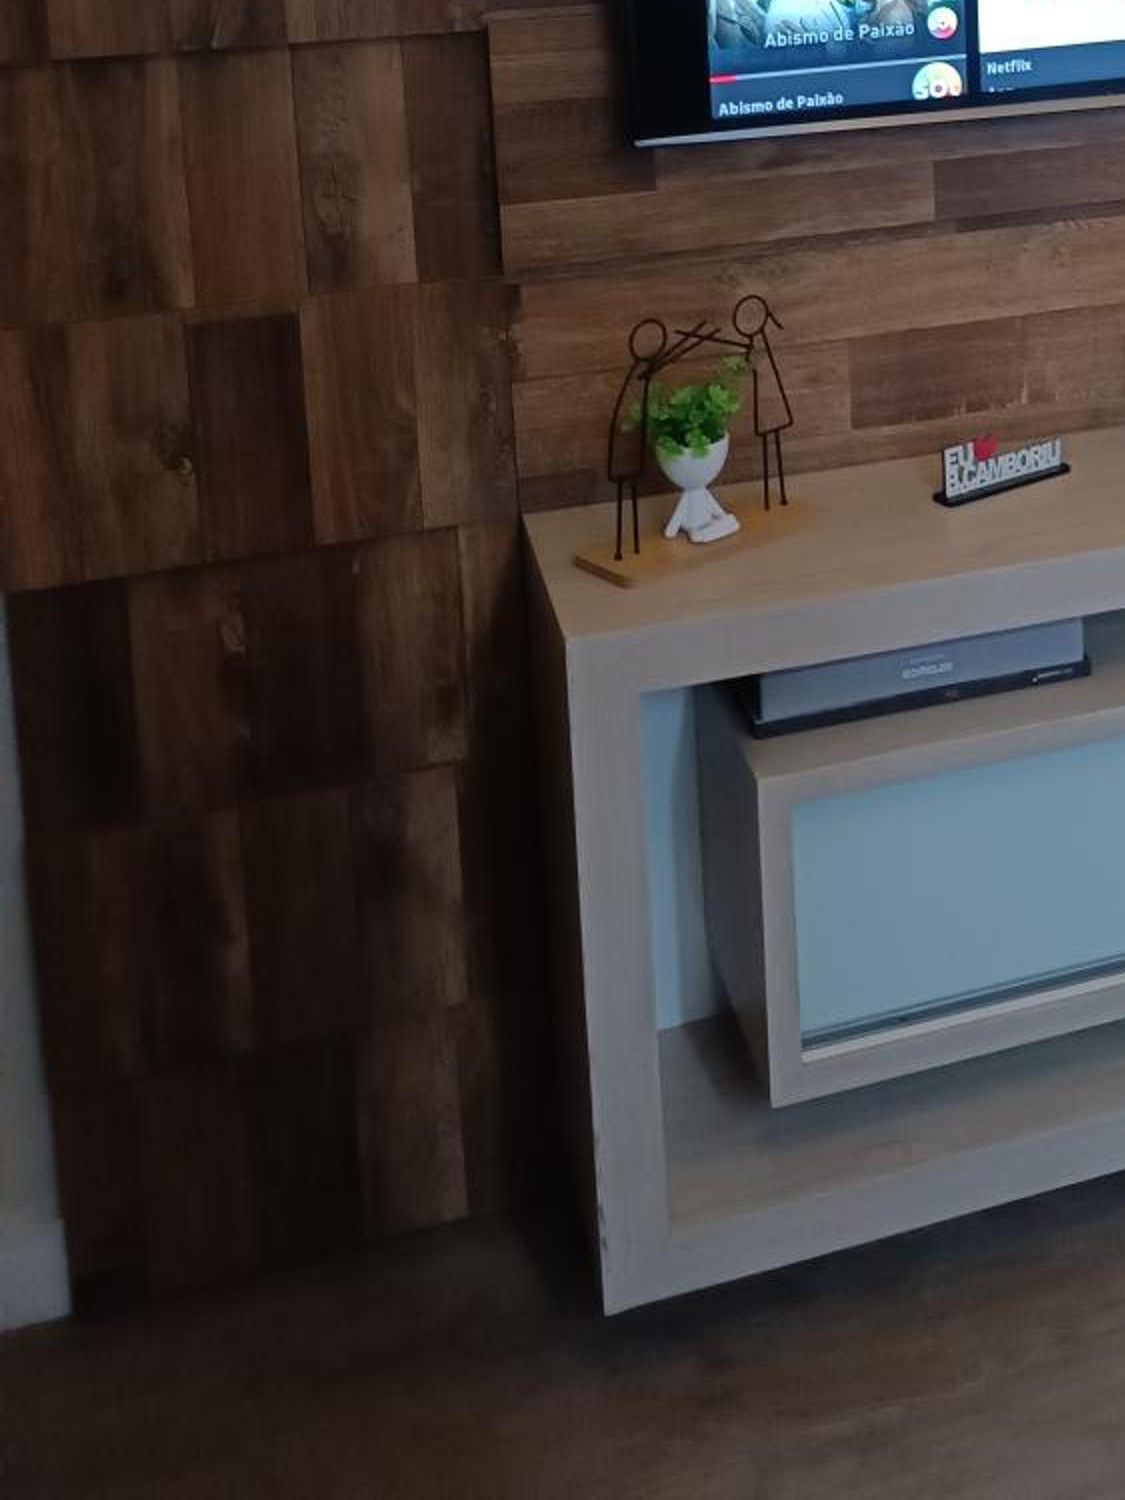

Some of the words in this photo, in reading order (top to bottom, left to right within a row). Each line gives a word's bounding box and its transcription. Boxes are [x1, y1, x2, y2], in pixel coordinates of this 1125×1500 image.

[763, 32, 829, 48] Abismo
[833, 26, 855, 42] de
[986, 59, 1033, 76] Netflix
[718, 101, 773, 117] Abismo
[776, 97, 793, 110] de
